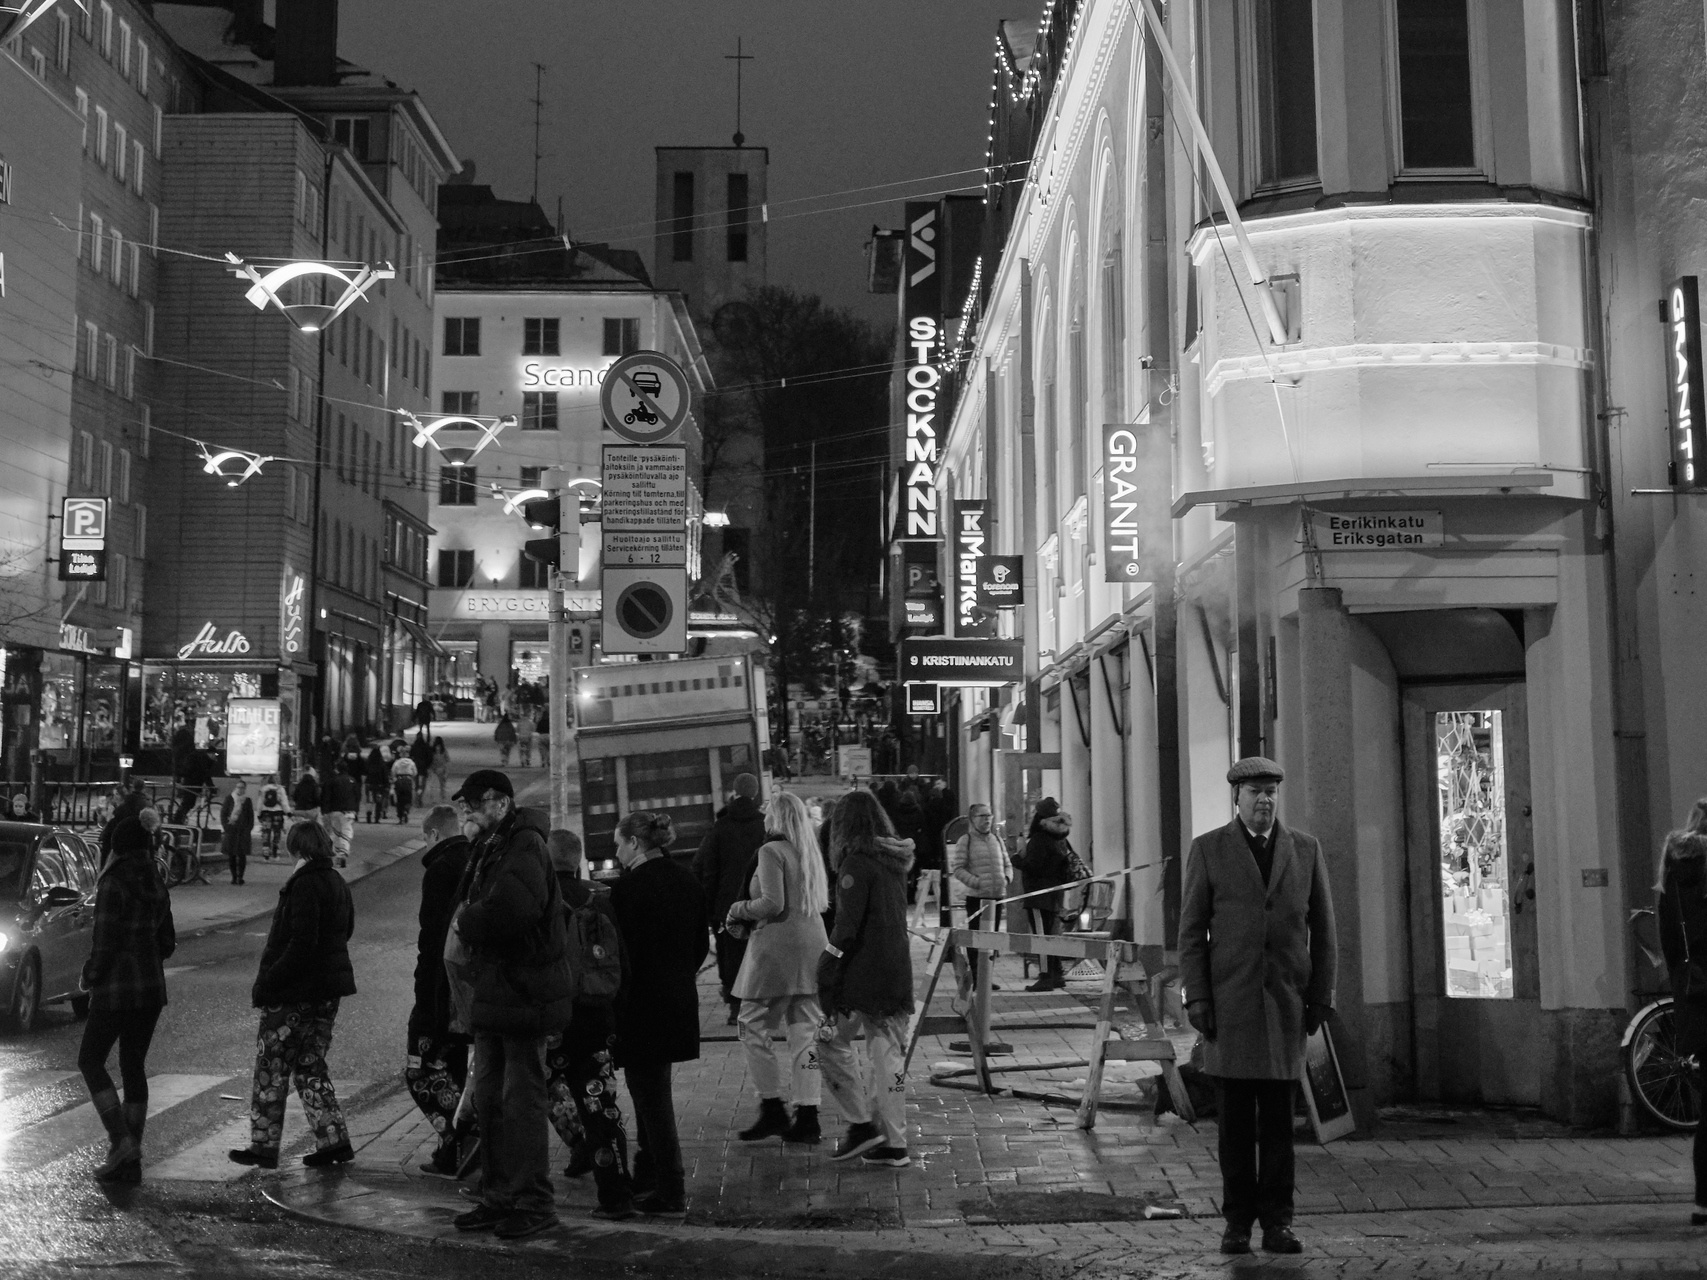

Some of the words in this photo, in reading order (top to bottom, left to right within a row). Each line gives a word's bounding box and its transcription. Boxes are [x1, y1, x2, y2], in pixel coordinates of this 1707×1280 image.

[906, 317, 938, 535] STOCKMANN
[645, 463, 684, 471] vammaisen
[668, 473, 679, 481] ajo
[604, 499, 652, 507] parkeringshus
[74, 510, 95, 534] P
[1330, 516, 1424, 529] Eerikinkatu
[613, 535, 650, 543] Huoltoajo
[653, 535, 681, 543] sallittu
[1333, 532, 1423, 547] Eriksgatan
[628, 553, 634, 563] 6
[650, 553, 661, 563] 12
[285, 575, 304, 652] Husso
[910, 656, 918, 666] 9
[922, 656, 1014, 666] KRISTIINANKATU
